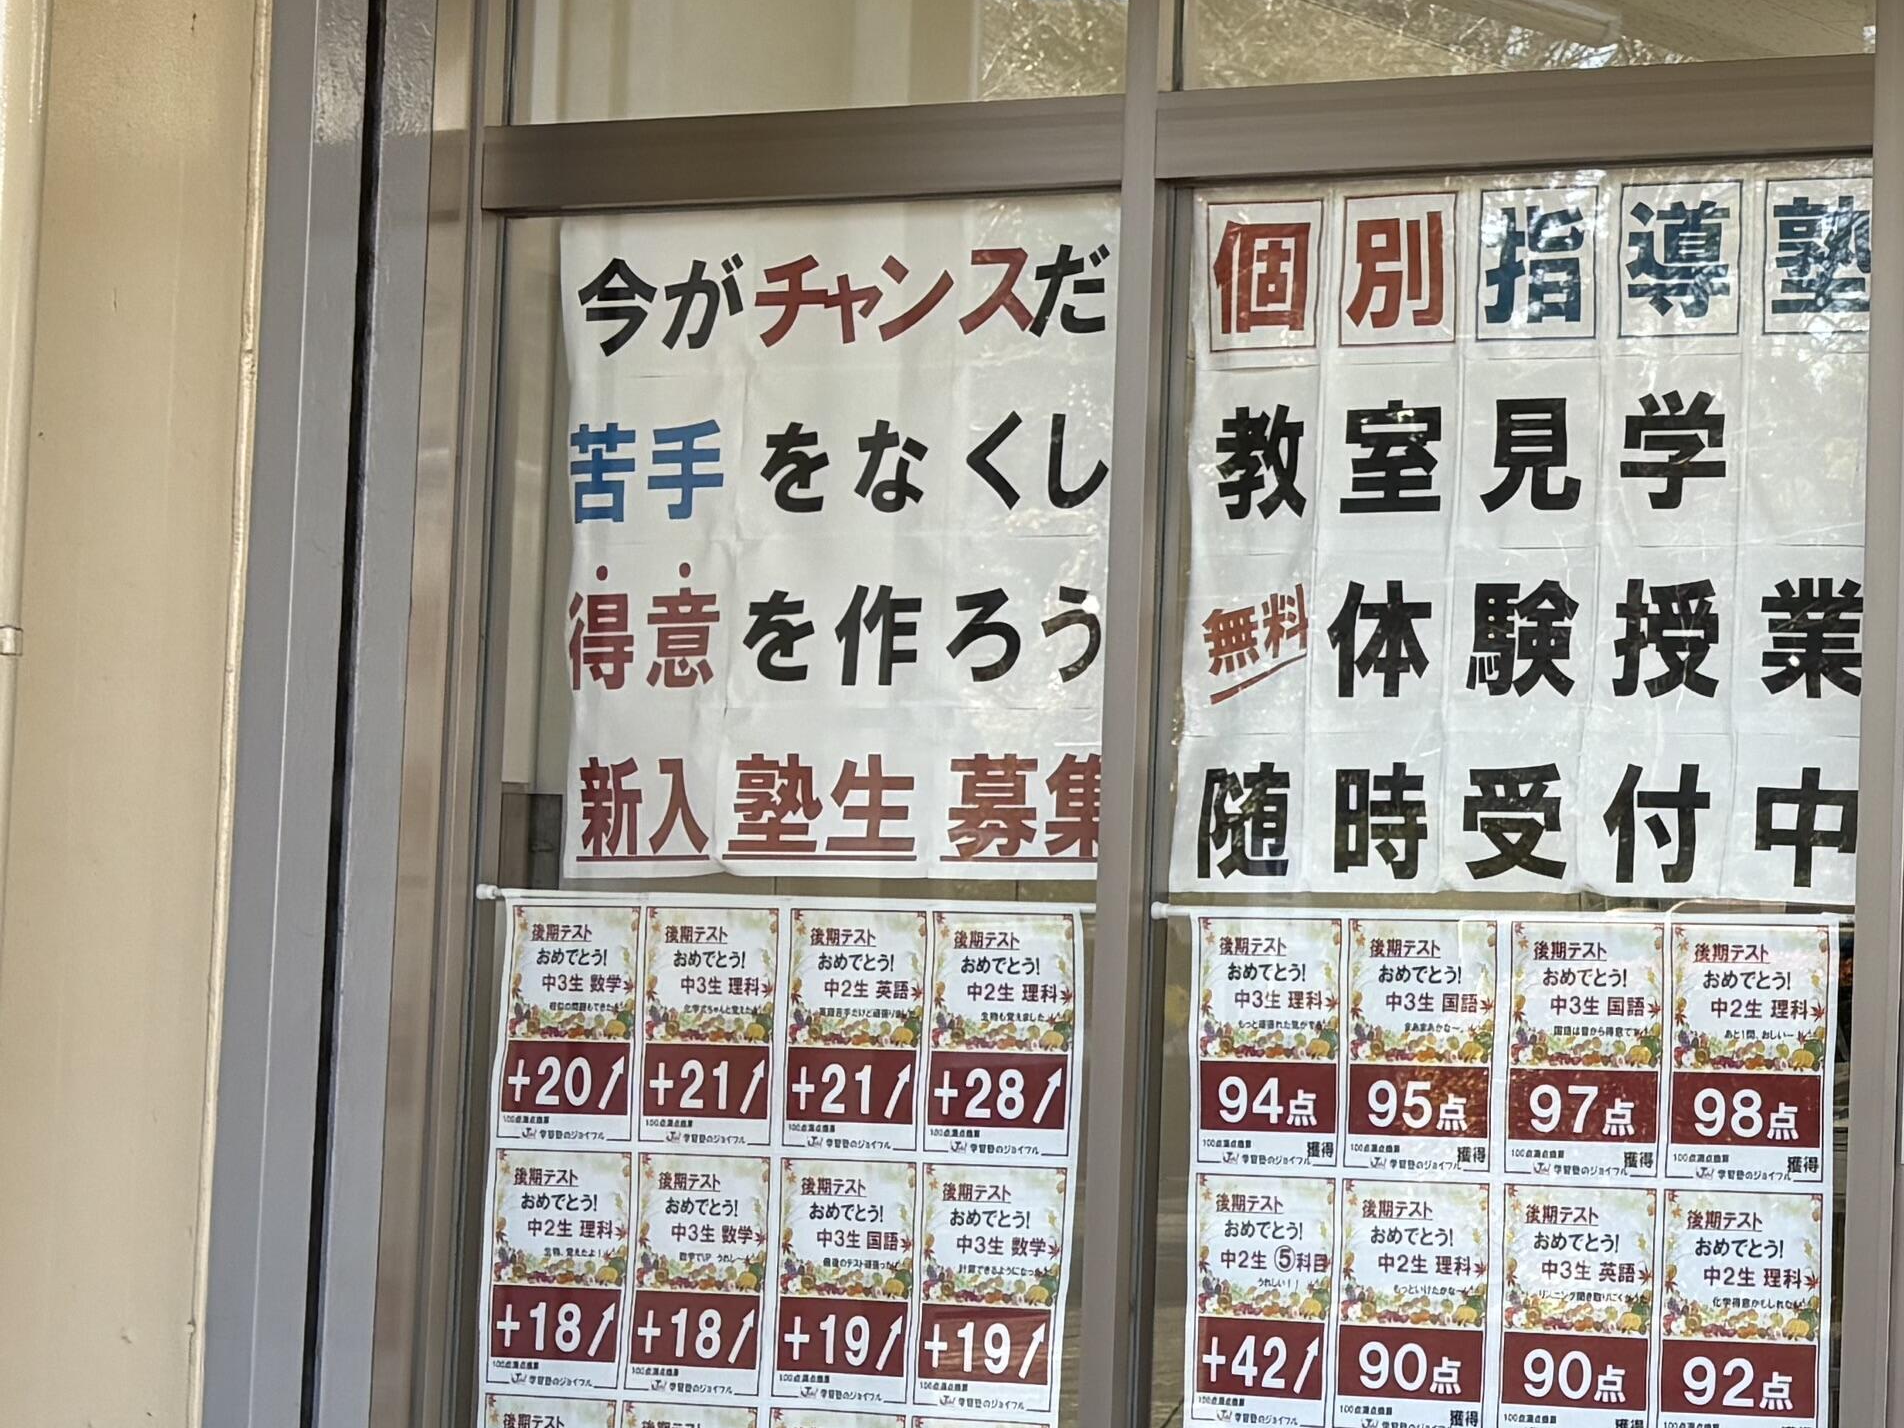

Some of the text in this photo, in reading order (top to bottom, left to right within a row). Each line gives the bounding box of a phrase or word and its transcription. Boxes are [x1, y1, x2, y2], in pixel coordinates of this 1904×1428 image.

[1212, 196, 1872, 334] 個別指導塾
[578, 244, 1110, 357] 今がチャンスだ
[570, 411, 1109, 524] 苦手をなくし
[1214, 390, 1727, 521] 教室見学
[569, 584, 1101, 691] 得意を作ろう
[1202, 578, 1863, 698] 無料 体験授業
[580, 752, 1101, 859] 新入塾生募集
[1197, 762, 1857, 888] 随時受付中
[531, 924, 592, 941] 後期テスト
[537, 949, 608, 966] おめでとう!
[1534, 942, 1607, 960] 後期テスト
[541, 976, 622, 993] 中3生 数学
[1543, 968, 1627, 987] おめでとう!
[1550, 996, 1645, 1017] 中3生 国語
[508, 1056, 591, 1106] +20
[650, 1060, 729, 1110] +21
[791, 1064, 872, 1115] +21
[934, 1068, 1025, 1120] +28
[1218, 1076, 1317, 1126] 94点
[1368, 1079, 1467, 1132] 95点
[1529, 1084, 1636, 1137] 97点
[1694, 1088, 1799, 1141] 98点
[496, 1301, 581, 1353] +18
[638, 1307, 721, 1359] +18
[784, 1314, 870, 1367] +19
[924, 1321, 1010, 1374] +19
[1202, 1335, 1288, 1390] +42
[1358, 1341, 1461, 1395] 90点
[1523, 1348, 1626, 1403] 90点
[1682, 1356, 1793, 1410] 92点
